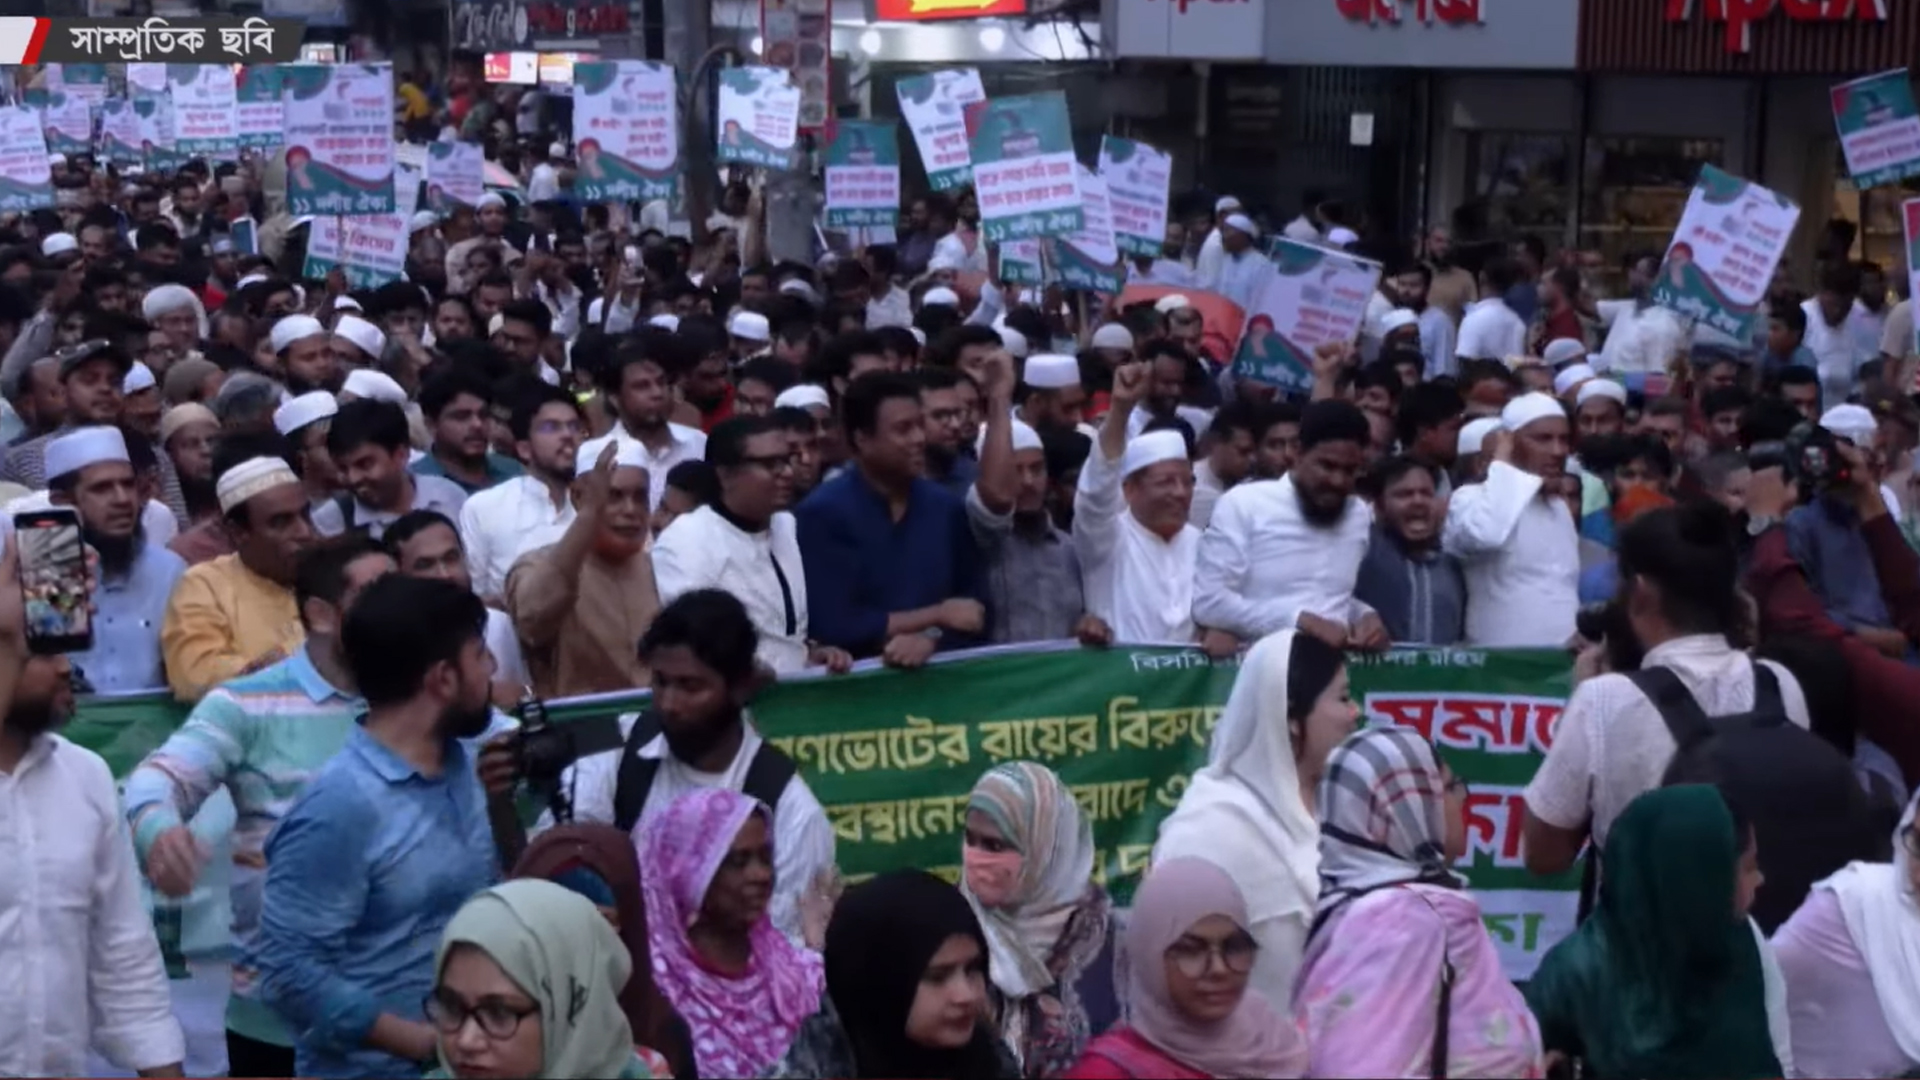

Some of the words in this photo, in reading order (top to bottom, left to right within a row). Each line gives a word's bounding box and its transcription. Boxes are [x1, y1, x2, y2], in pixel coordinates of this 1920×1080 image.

[979, 715, 1098, 762] রায়ের
[824, 795, 972, 844] বস্থানে
[1068, 778, 1150, 820] বাদে
